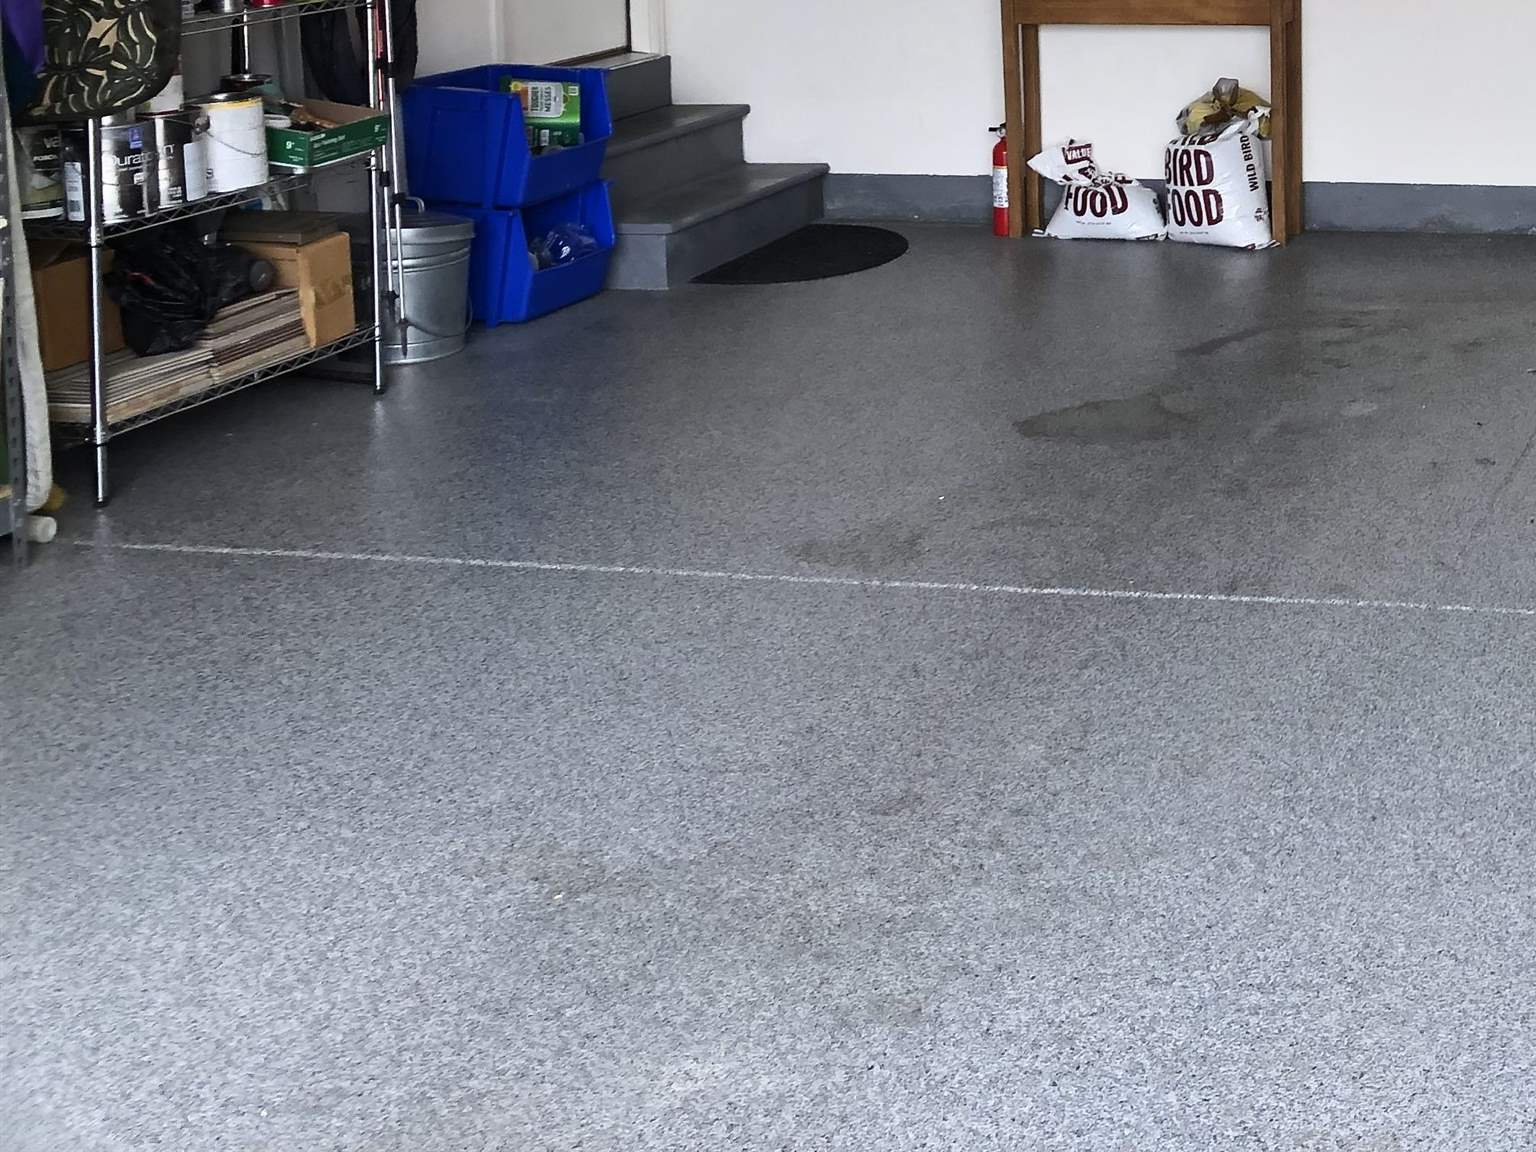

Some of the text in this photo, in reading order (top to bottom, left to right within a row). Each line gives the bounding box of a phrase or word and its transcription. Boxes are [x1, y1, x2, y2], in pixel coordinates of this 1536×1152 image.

[544, 86, 552, 112] MESSES
[1066, 148, 1092, 160] VALUE
[1165, 147, 1214, 186] BIRD
[1240, 135, 1260, 192] WILD BIRD
[1064, 184, 1128, 217] FOOD
